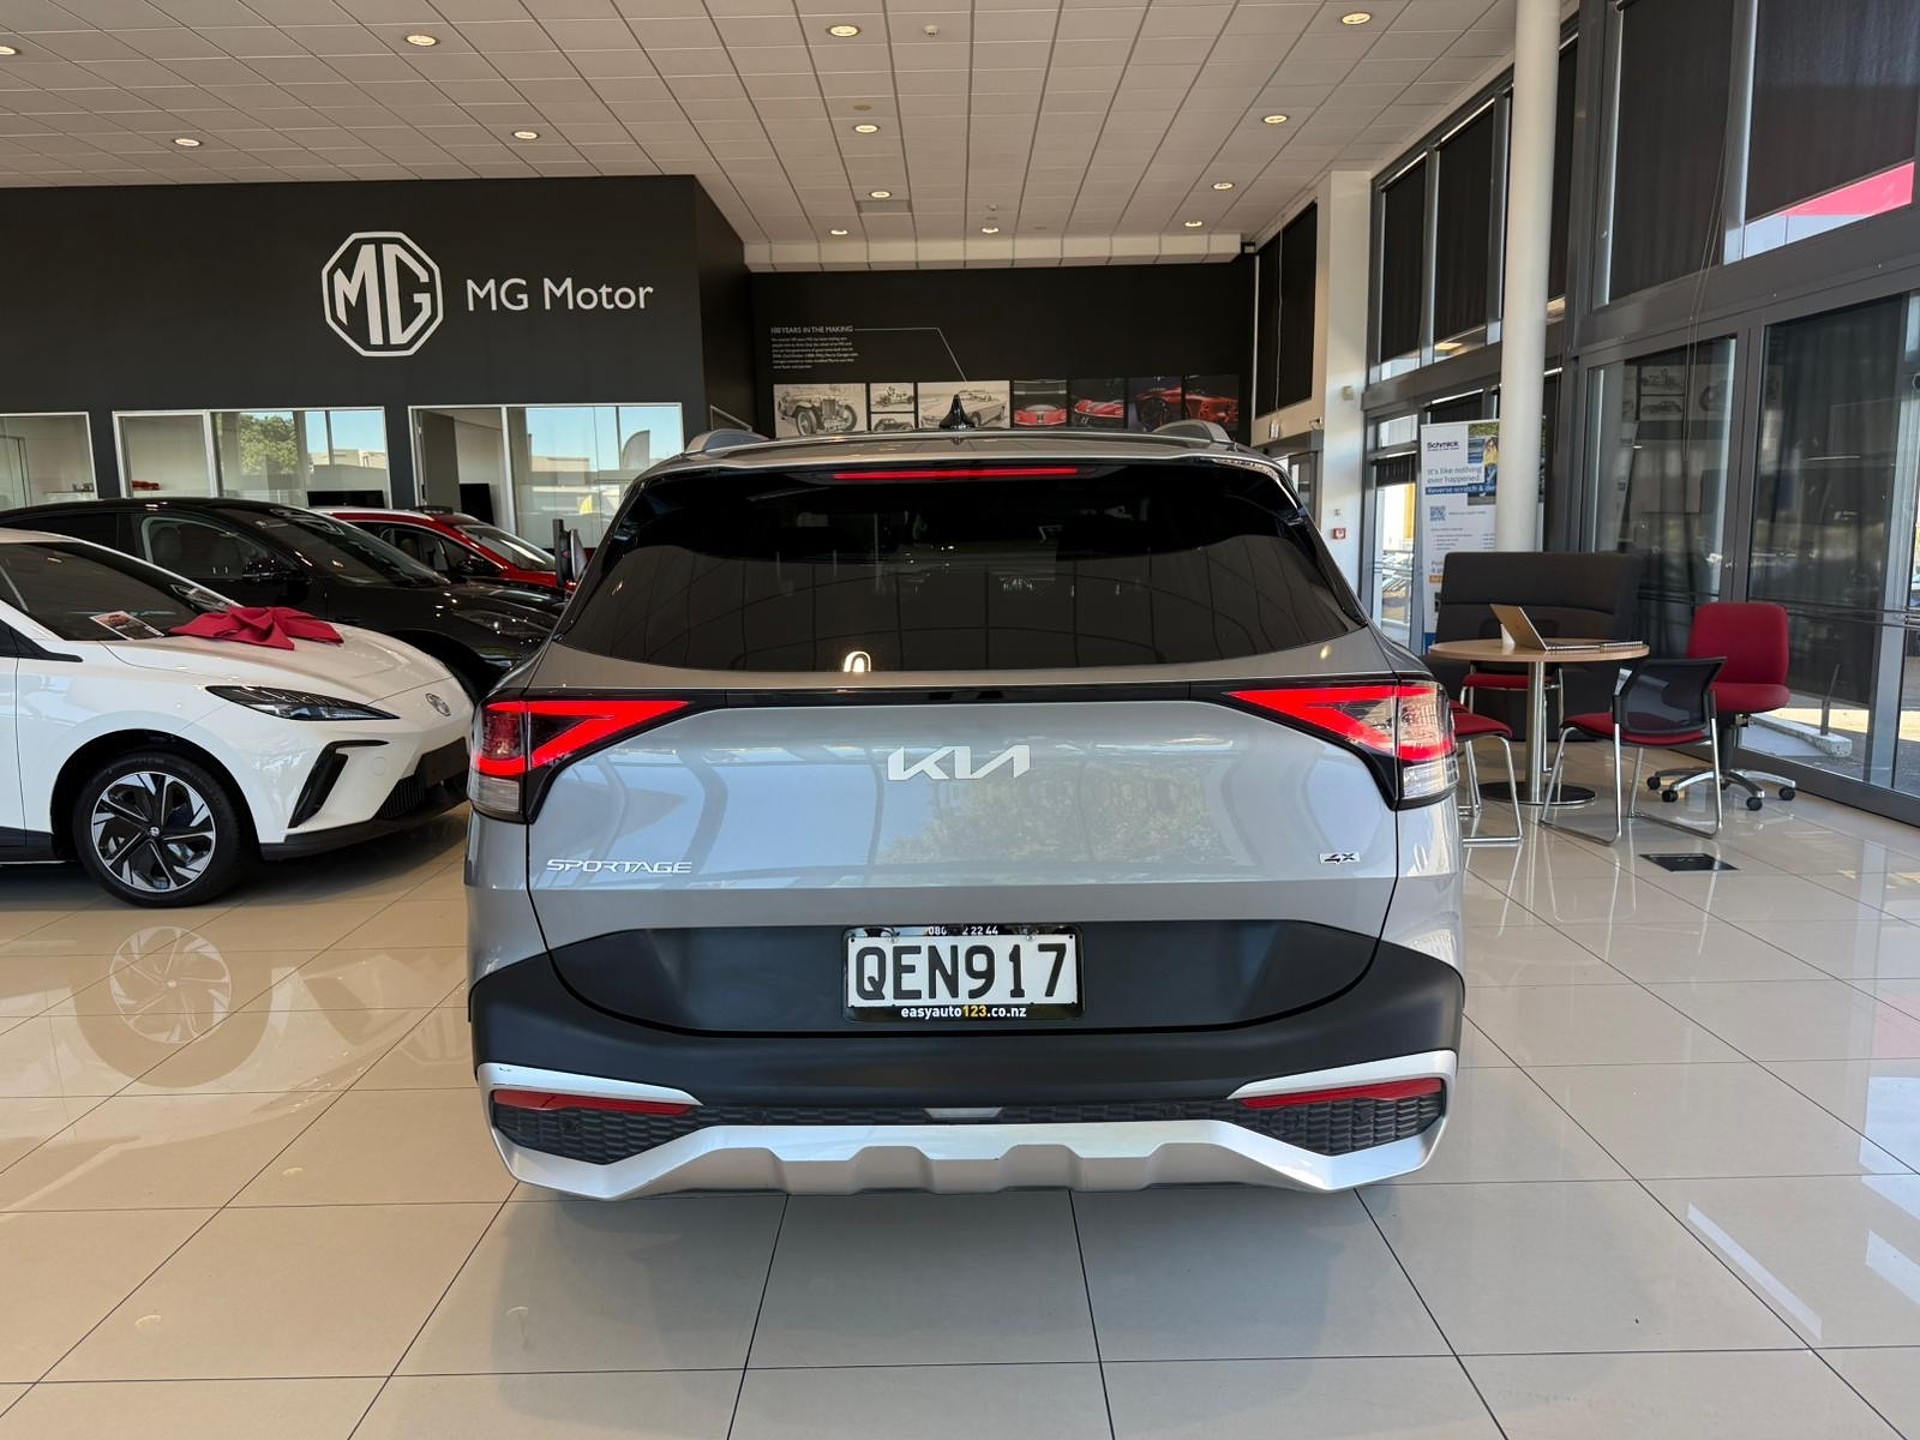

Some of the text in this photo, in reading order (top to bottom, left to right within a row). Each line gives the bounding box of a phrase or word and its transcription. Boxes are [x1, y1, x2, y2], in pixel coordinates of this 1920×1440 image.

[332, 243, 432, 346] MG
[466, 277, 654, 312] MG Motor
[803, 325, 811, 333] IN
[811, 325, 825, 333] THE
[826, 325, 854, 333] MAKING
[888, 745, 1031, 780] KIA
[547, 859, 692, 873] SPORTAGE
[856, 944, 1067, 1000] QEN917
[901, 1005, 1027, 1020] easyauto123.co.nz
